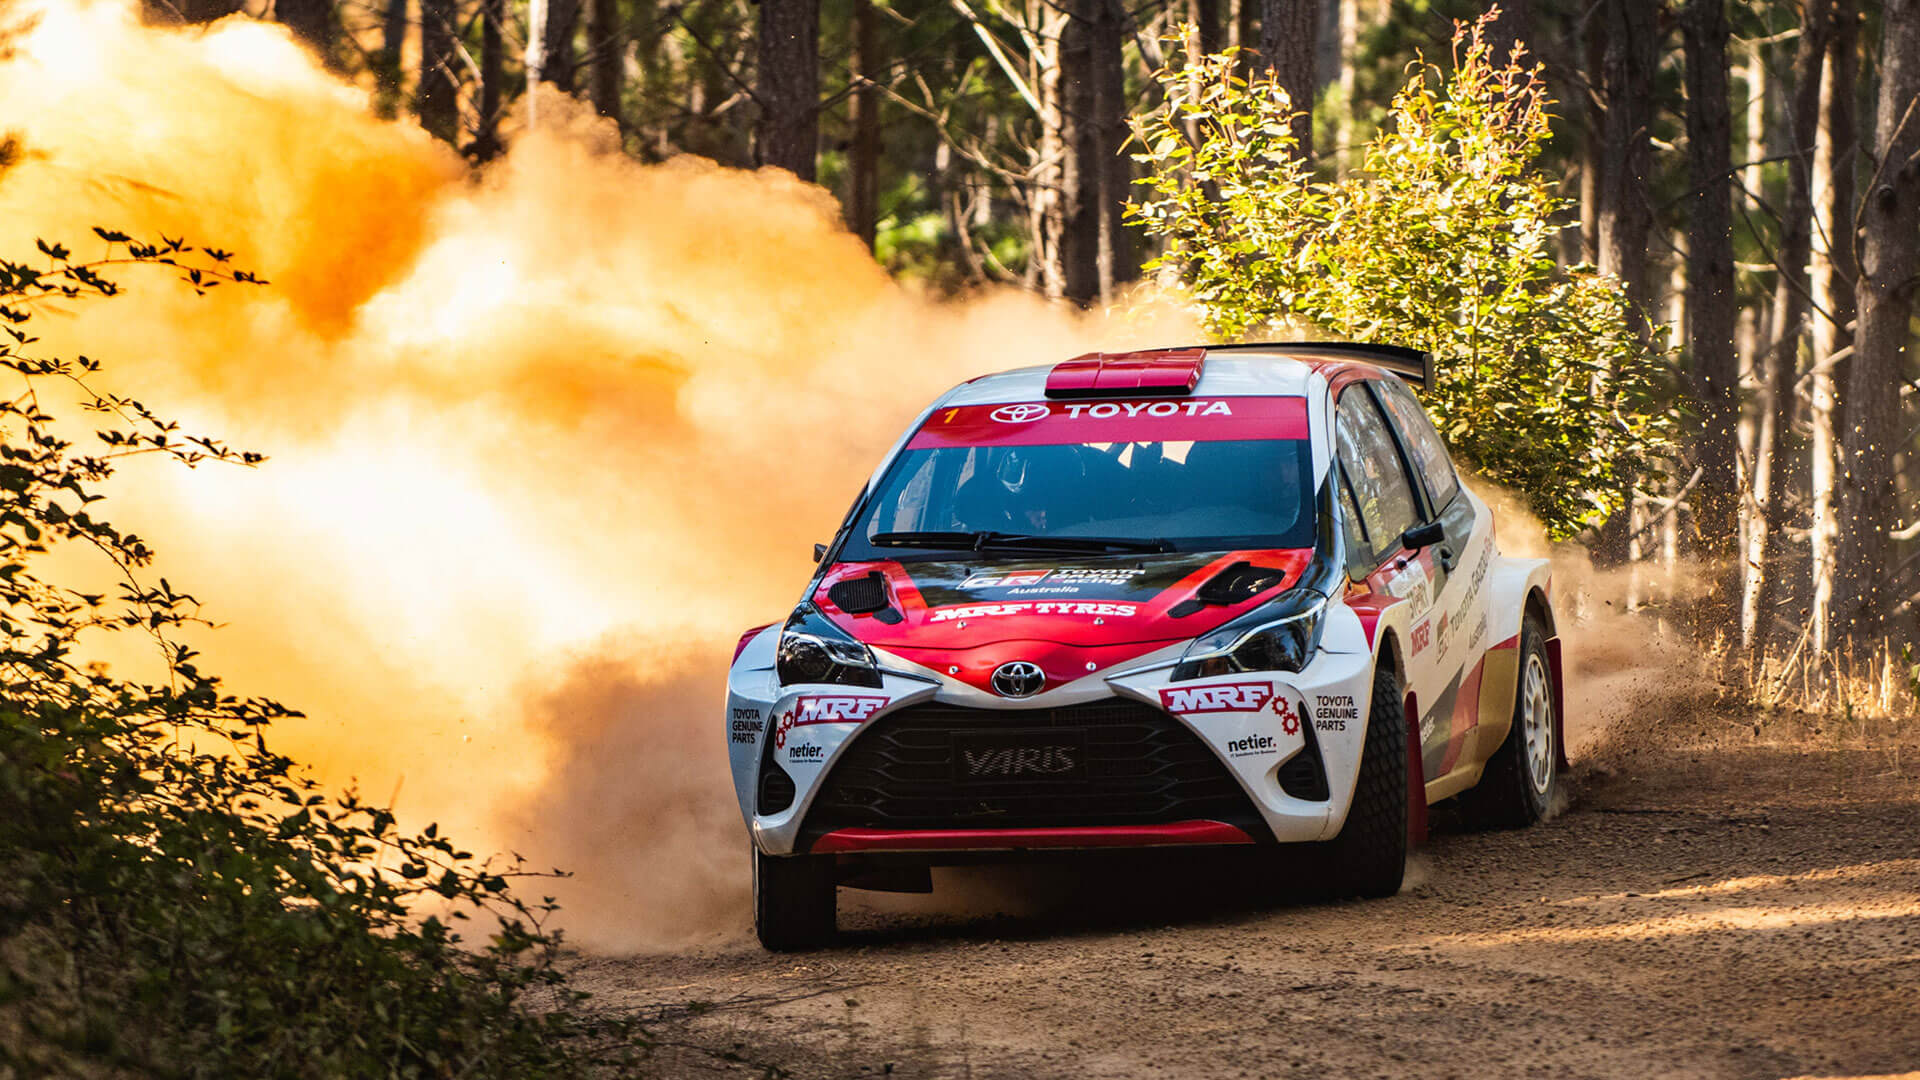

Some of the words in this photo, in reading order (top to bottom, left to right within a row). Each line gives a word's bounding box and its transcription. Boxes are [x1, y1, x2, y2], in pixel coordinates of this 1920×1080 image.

[1064, 401, 1232, 419] TOYOTA
[962, 575, 1041, 590] GR
[1007, 586, 1080, 594] Australia
[930, 604, 1032, 621] MRF
[1035, 603, 1137, 617] TYRES
[1411, 619, 1431, 656] MRF
[1167, 686, 1268, 711] MRF
[1316, 696, 1354, 706] TOYOTA
[733, 708, 761, 720] TOYOTA
[797, 699, 884, 721] MRF
[1316, 708, 1358, 719] GENUINE
[732, 721, 763, 732] GENUINE
[1316, 720, 1346, 731] PARTS
[732, 733, 756, 744] PARTS
